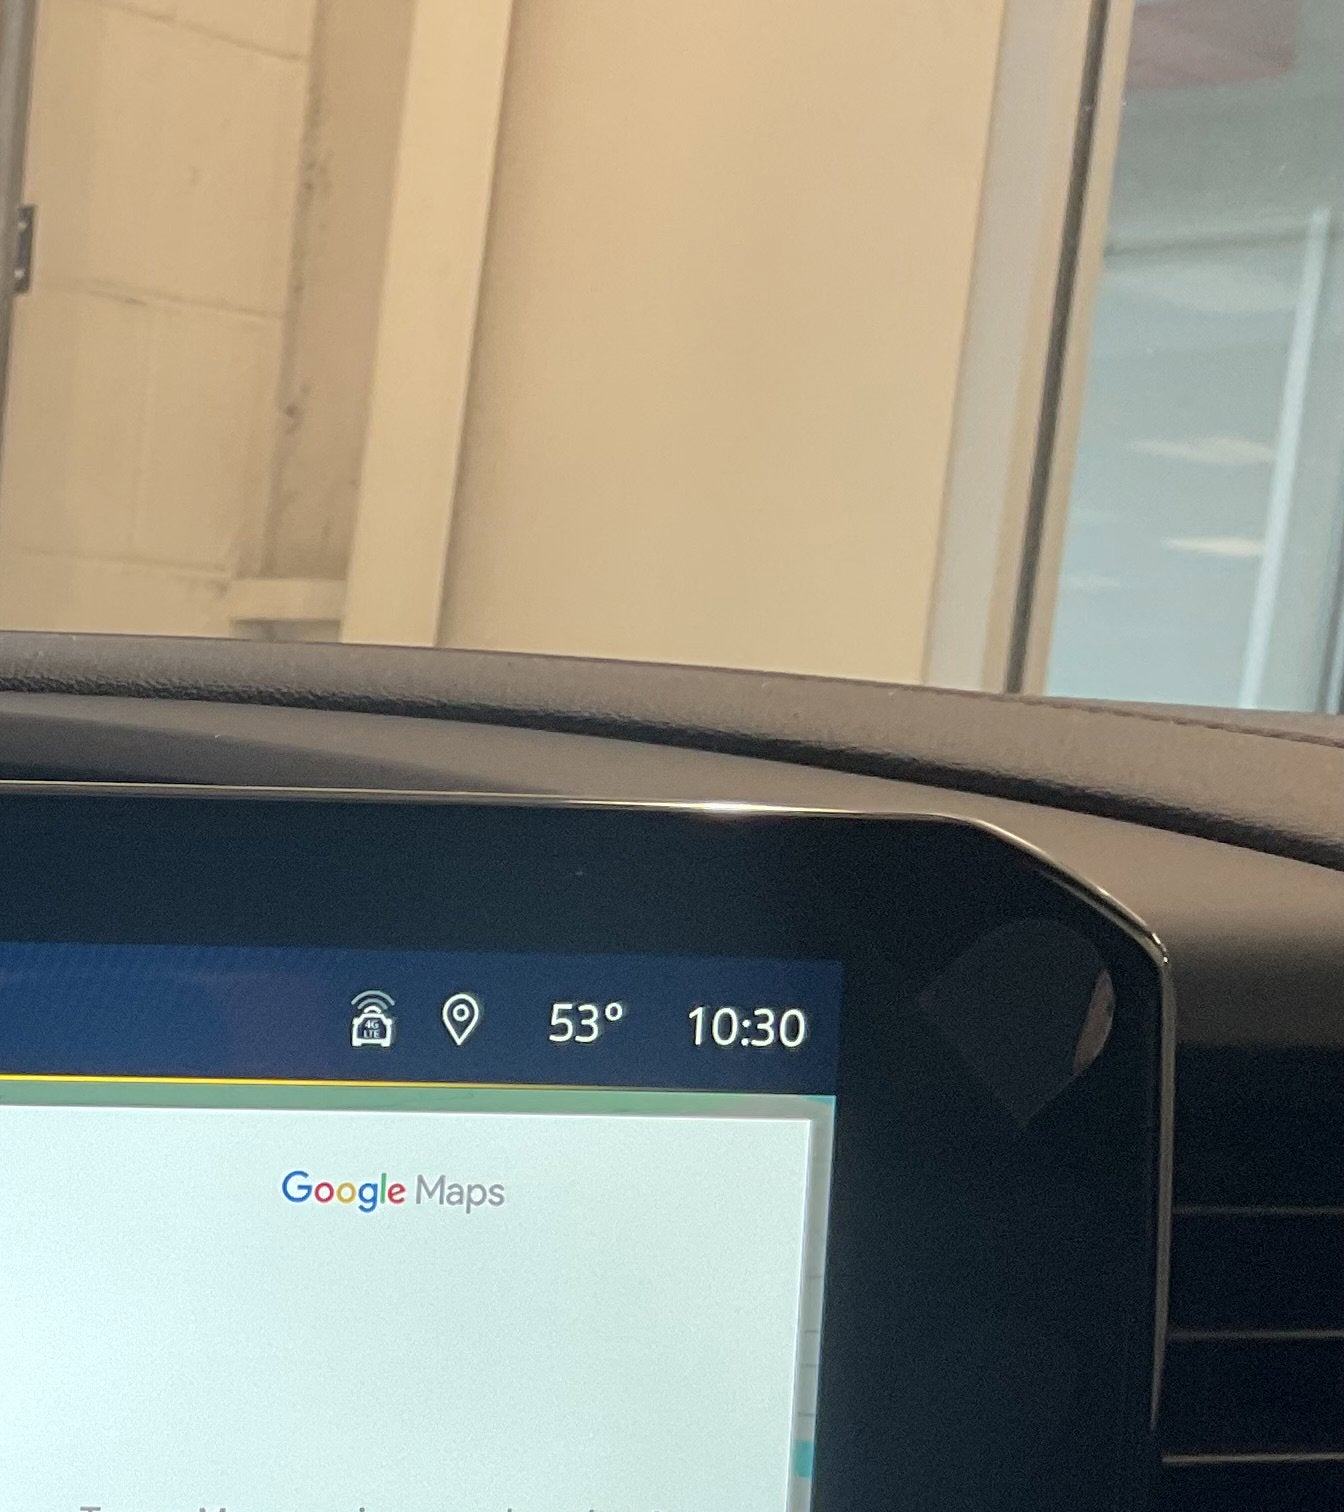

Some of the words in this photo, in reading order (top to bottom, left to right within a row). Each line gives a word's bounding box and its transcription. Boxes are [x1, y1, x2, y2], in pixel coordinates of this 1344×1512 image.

[364, 1020, 380, 1029] 4G
[689, 1007, 806, 1047] 10:30
[282, 1171, 405, 1213] Google
[416, 1175, 504, 1214] Maps
